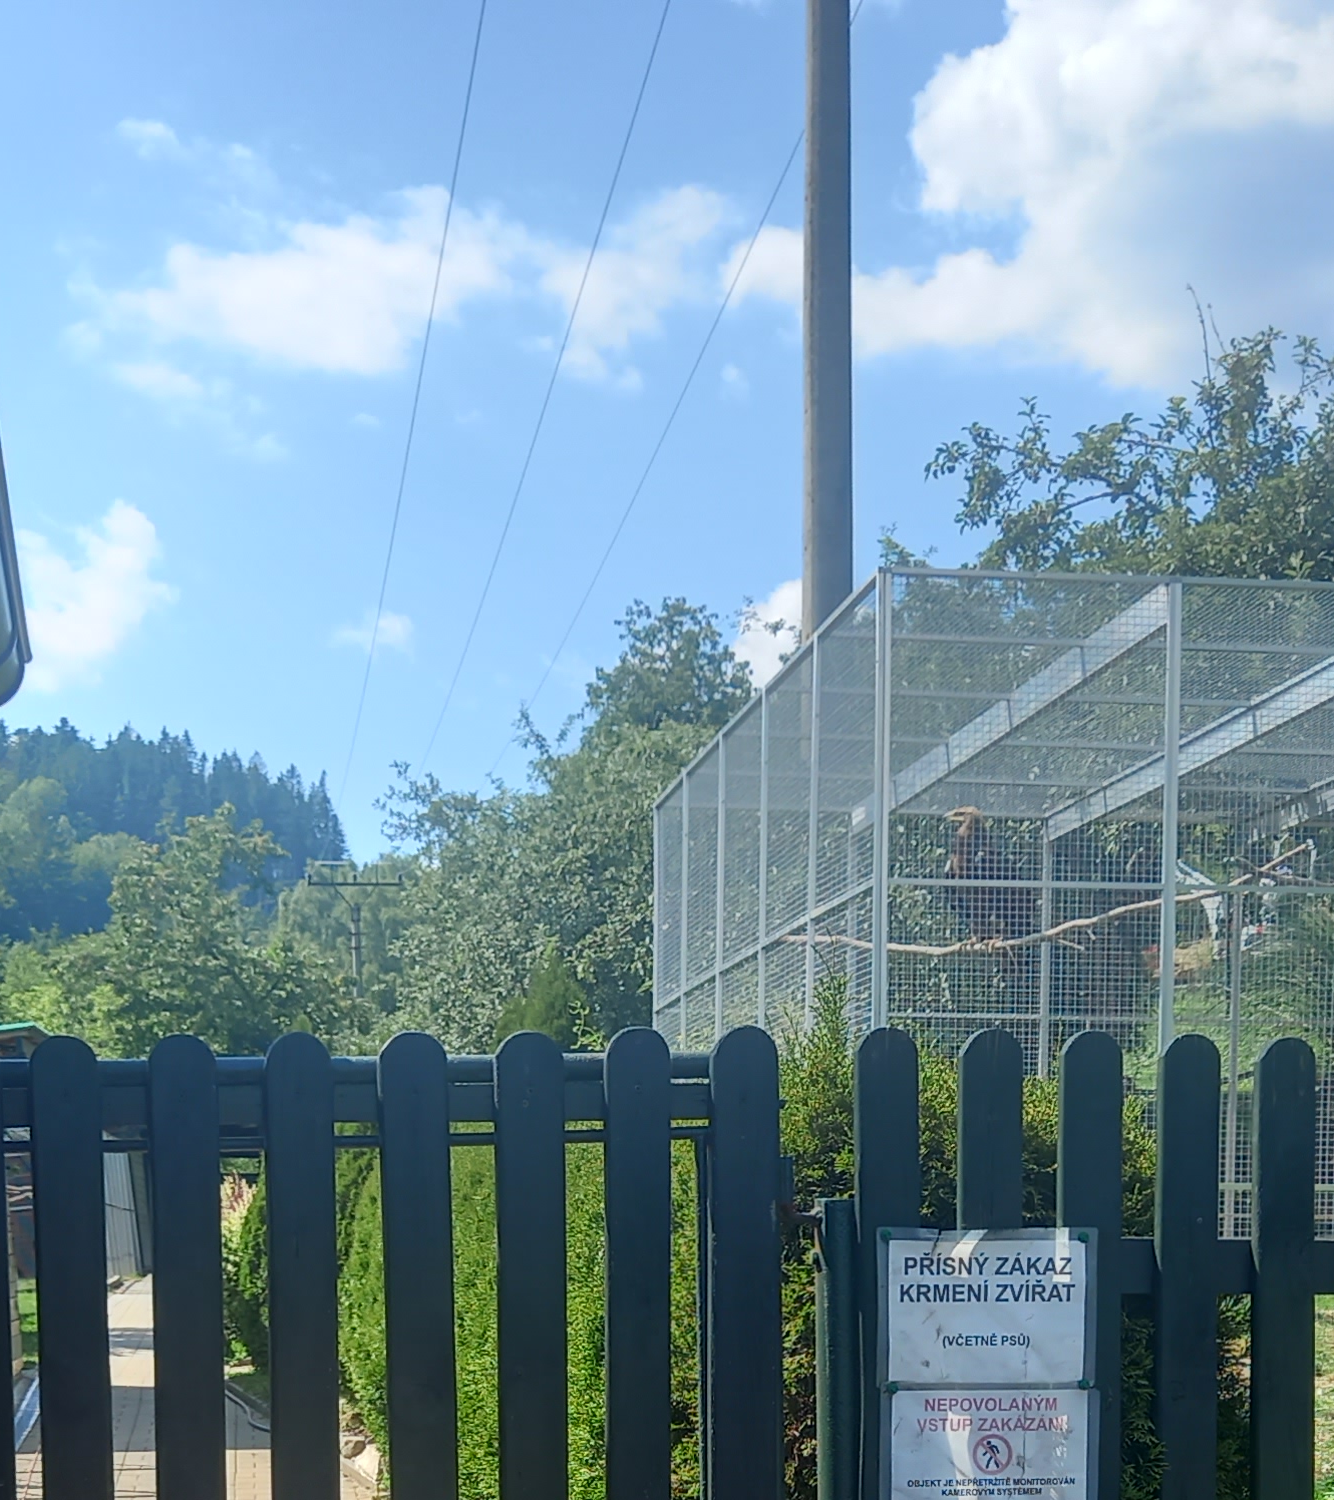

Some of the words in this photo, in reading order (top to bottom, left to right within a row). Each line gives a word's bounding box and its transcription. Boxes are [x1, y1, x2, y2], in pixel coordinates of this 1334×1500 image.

[904, 1252, 989, 1275] PŘÍSNÝ
[994, 1253, 1072, 1275] ZÁKAZ
[899, 1280, 988, 1302] KRMENÍ
[995, 1280, 1075, 1302] ZVÍŘAT
[942, 1333, 998, 1348] (VČETNĚ
[1001, 1333, 1030, 1348] PSŮ)
[924, 1394, 1057, 1412] NEPOVOLANÝM
[917, 1417, 973, 1432] VSTUP
[907, 1479, 942, 1487] OBJEKT
[943, 1479, 954, 1487] JE
[1013, 1476, 1075, 1485] MONITOROVÁN
[997, 1487, 1042, 1495] SYSTÉMEM
